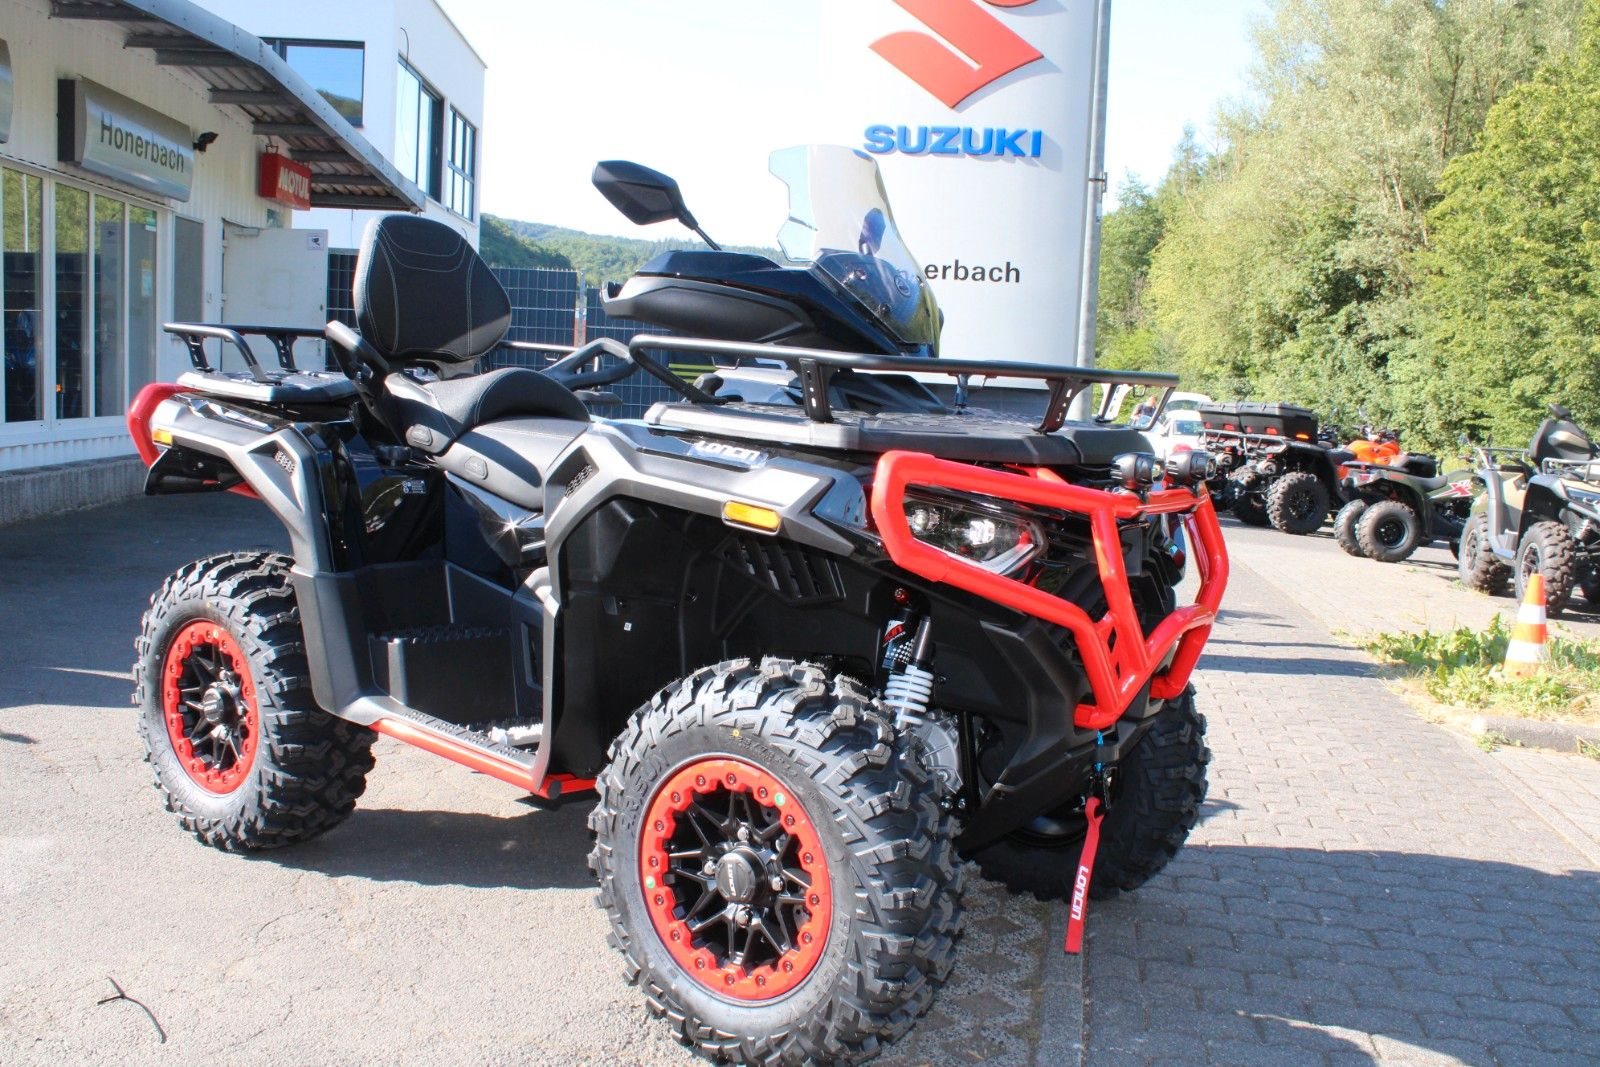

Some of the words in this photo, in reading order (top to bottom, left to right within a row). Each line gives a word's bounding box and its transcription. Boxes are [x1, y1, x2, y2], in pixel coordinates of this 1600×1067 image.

[101, 112, 184, 173] Honerbach
[863, 124, 1042, 158] SUZUKI
[278, 165, 311, 200] MOTUL
[924, 258, 1021, 284] erbach
